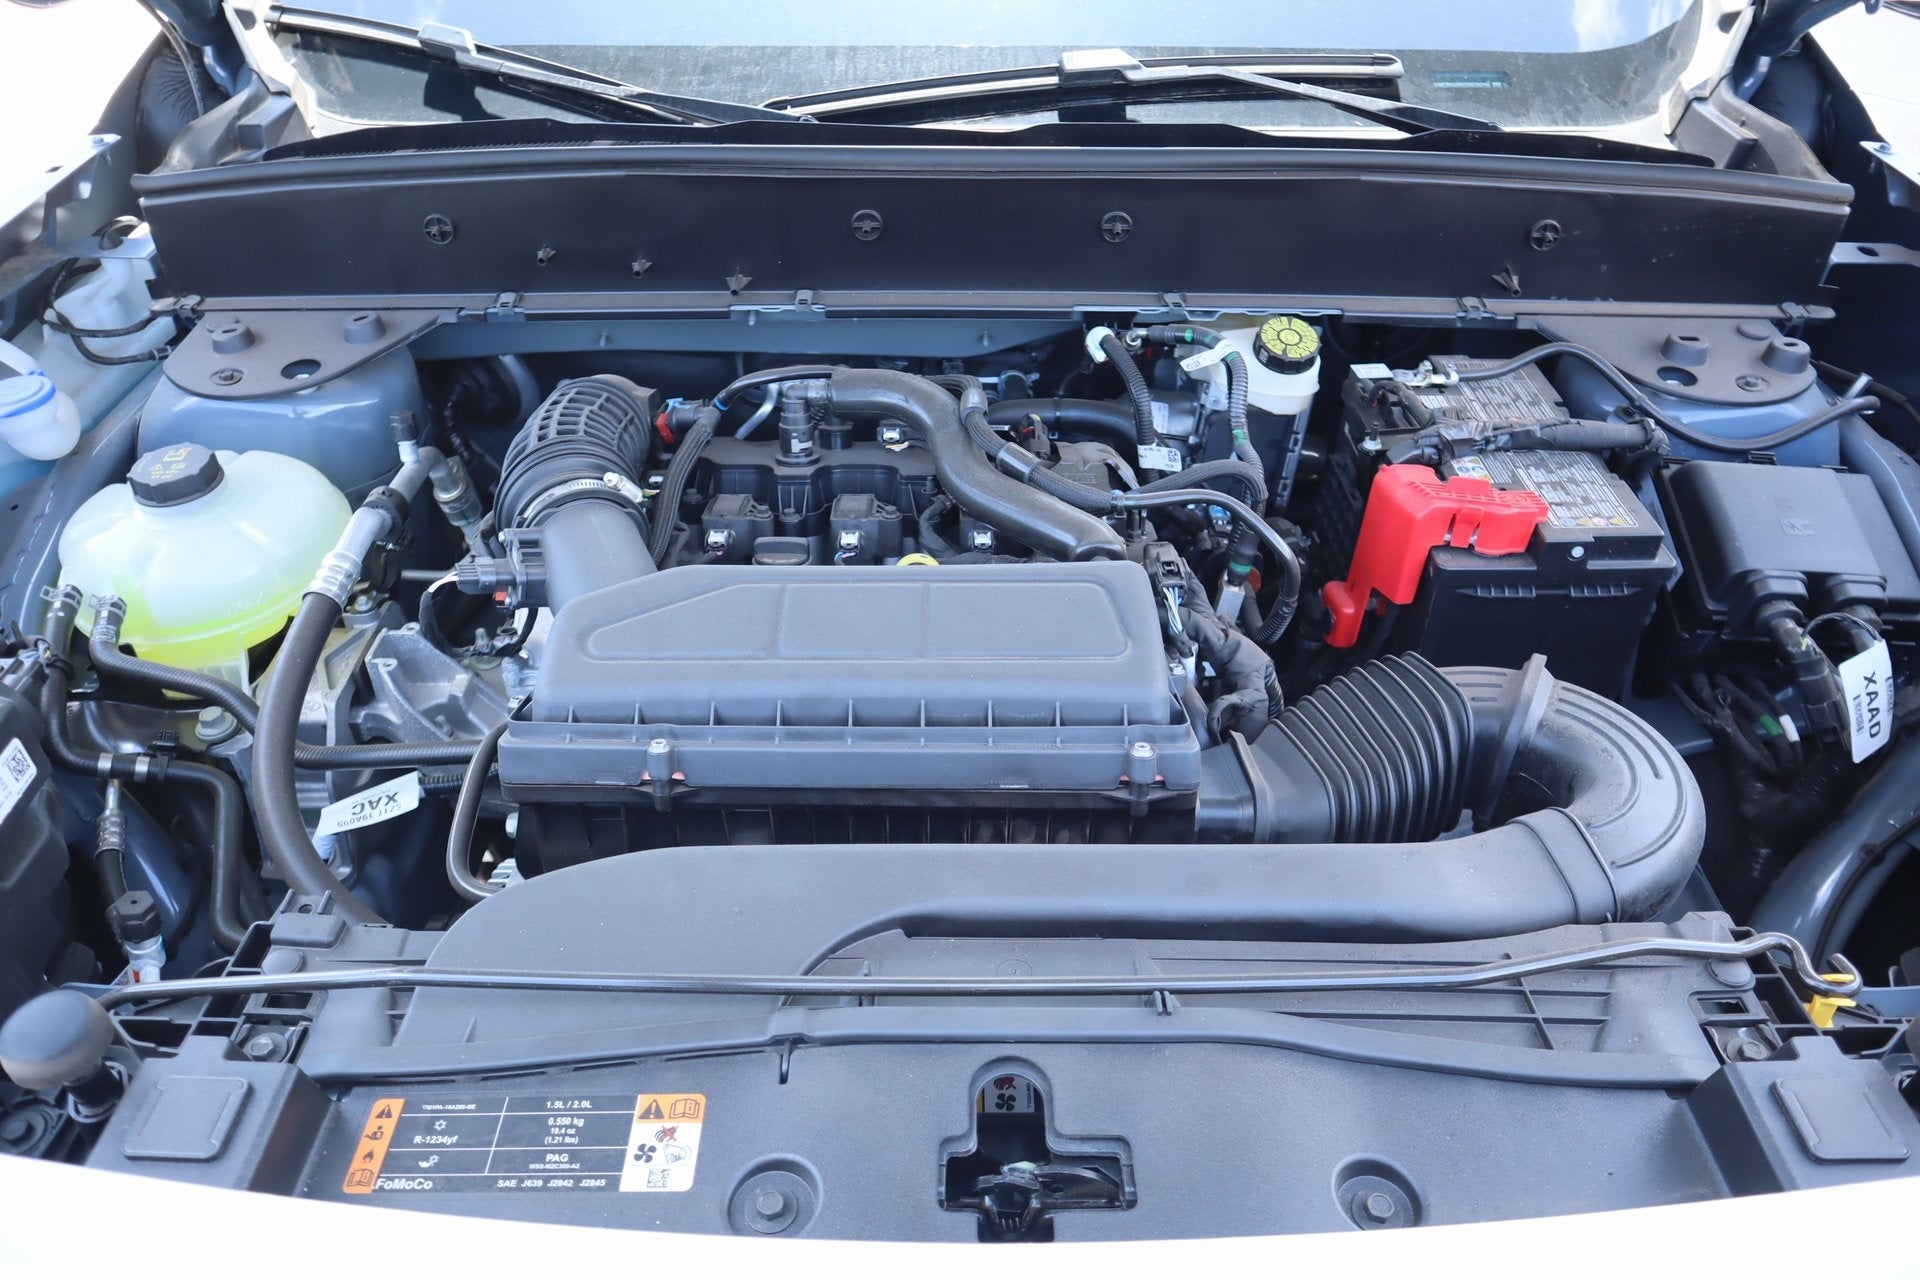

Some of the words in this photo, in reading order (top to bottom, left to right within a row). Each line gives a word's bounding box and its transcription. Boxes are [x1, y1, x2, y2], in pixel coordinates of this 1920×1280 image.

[1863, 671, 1881, 739] XAAD
[351, 791, 399, 816] XAC
[546, 1100, 565, 1109] 1.5L
[572, 1100, 592, 1109] 2.0L
[547, 1117, 572, 1126] 0.550
[572, 1117, 585, 1127] kg
[413, 1135, 459, 1146] R-1234yf
[544, 1136, 563, 1146] (1.21
[563, 1136, 579, 1145] lbs)
[545, 1153, 569, 1163] PAG
[375, 1177, 434, 1190] FoMoCo
[497, 1179, 518, 1188] SAE
[521, 1179, 544, 1188] J639
[547, 1179, 574, 1188] J2842
[579, 1179, 606, 1188] J2845
